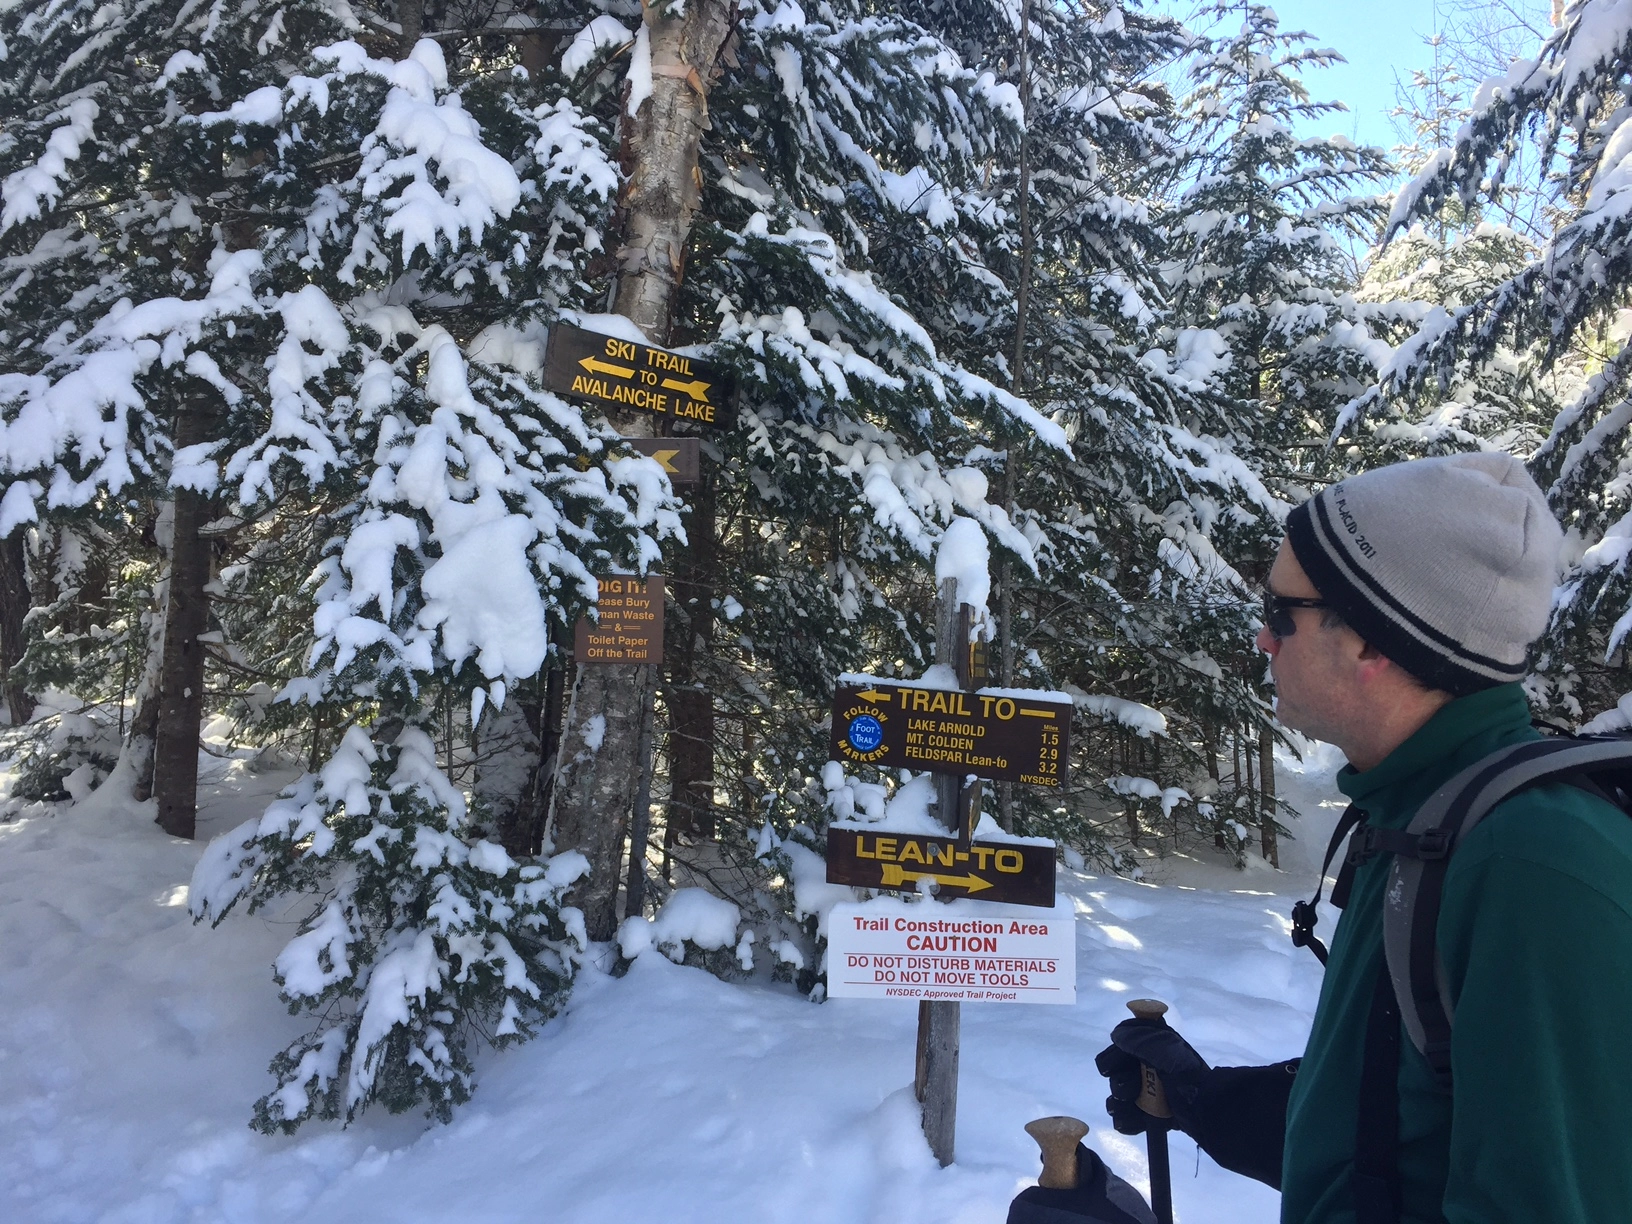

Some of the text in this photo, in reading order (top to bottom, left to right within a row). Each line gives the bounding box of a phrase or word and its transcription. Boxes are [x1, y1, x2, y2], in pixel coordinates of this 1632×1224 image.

[605, 338, 694, 377] SKI TRAIL
[639, 369, 658, 386] TO
[571, 375, 716, 423] AVALANCHE LAKE
[1336, 499, 1358, 535] PLACID
[1355, 535, 1377, 559] 2011
[598, 597, 650, 610] ease Bury
[599, 610, 655, 620] man Waste
[614, 623, 622, 632] &
[587, 635, 649, 647] Toilet Paper
[587, 648, 647, 659] Off the Trail
[897, 688, 1016, 720] TRAIL TO
[843, 705, 889, 723] FOLLOW
[907, 718, 1059, 746] LAKE ARNOLD 1.5
[837, 739, 890, 762] MARKERS
[906, 732, 1059, 760] MT. COLDEN 2.9
[905, 746, 1058, 775] FELDSPAR Lean-to 3.2
[1020, 774, 1059, 787] NYSDEC
[855, 835, 1024, 874] LEAN-TO
[853, 916, 1048, 936] Trail Construction Area
[906, 934, 998, 953] CAUTION
[847, 955, 1056, 973] DO NOT DISTURB MATERIALS
[874, 970, 1029, 986] DO NOT MOVE TOOLS
[885, 988, 1017, 1001] NYSDEC Approved Trail Project
[1145, 1066, 1157, 1097] EKI
